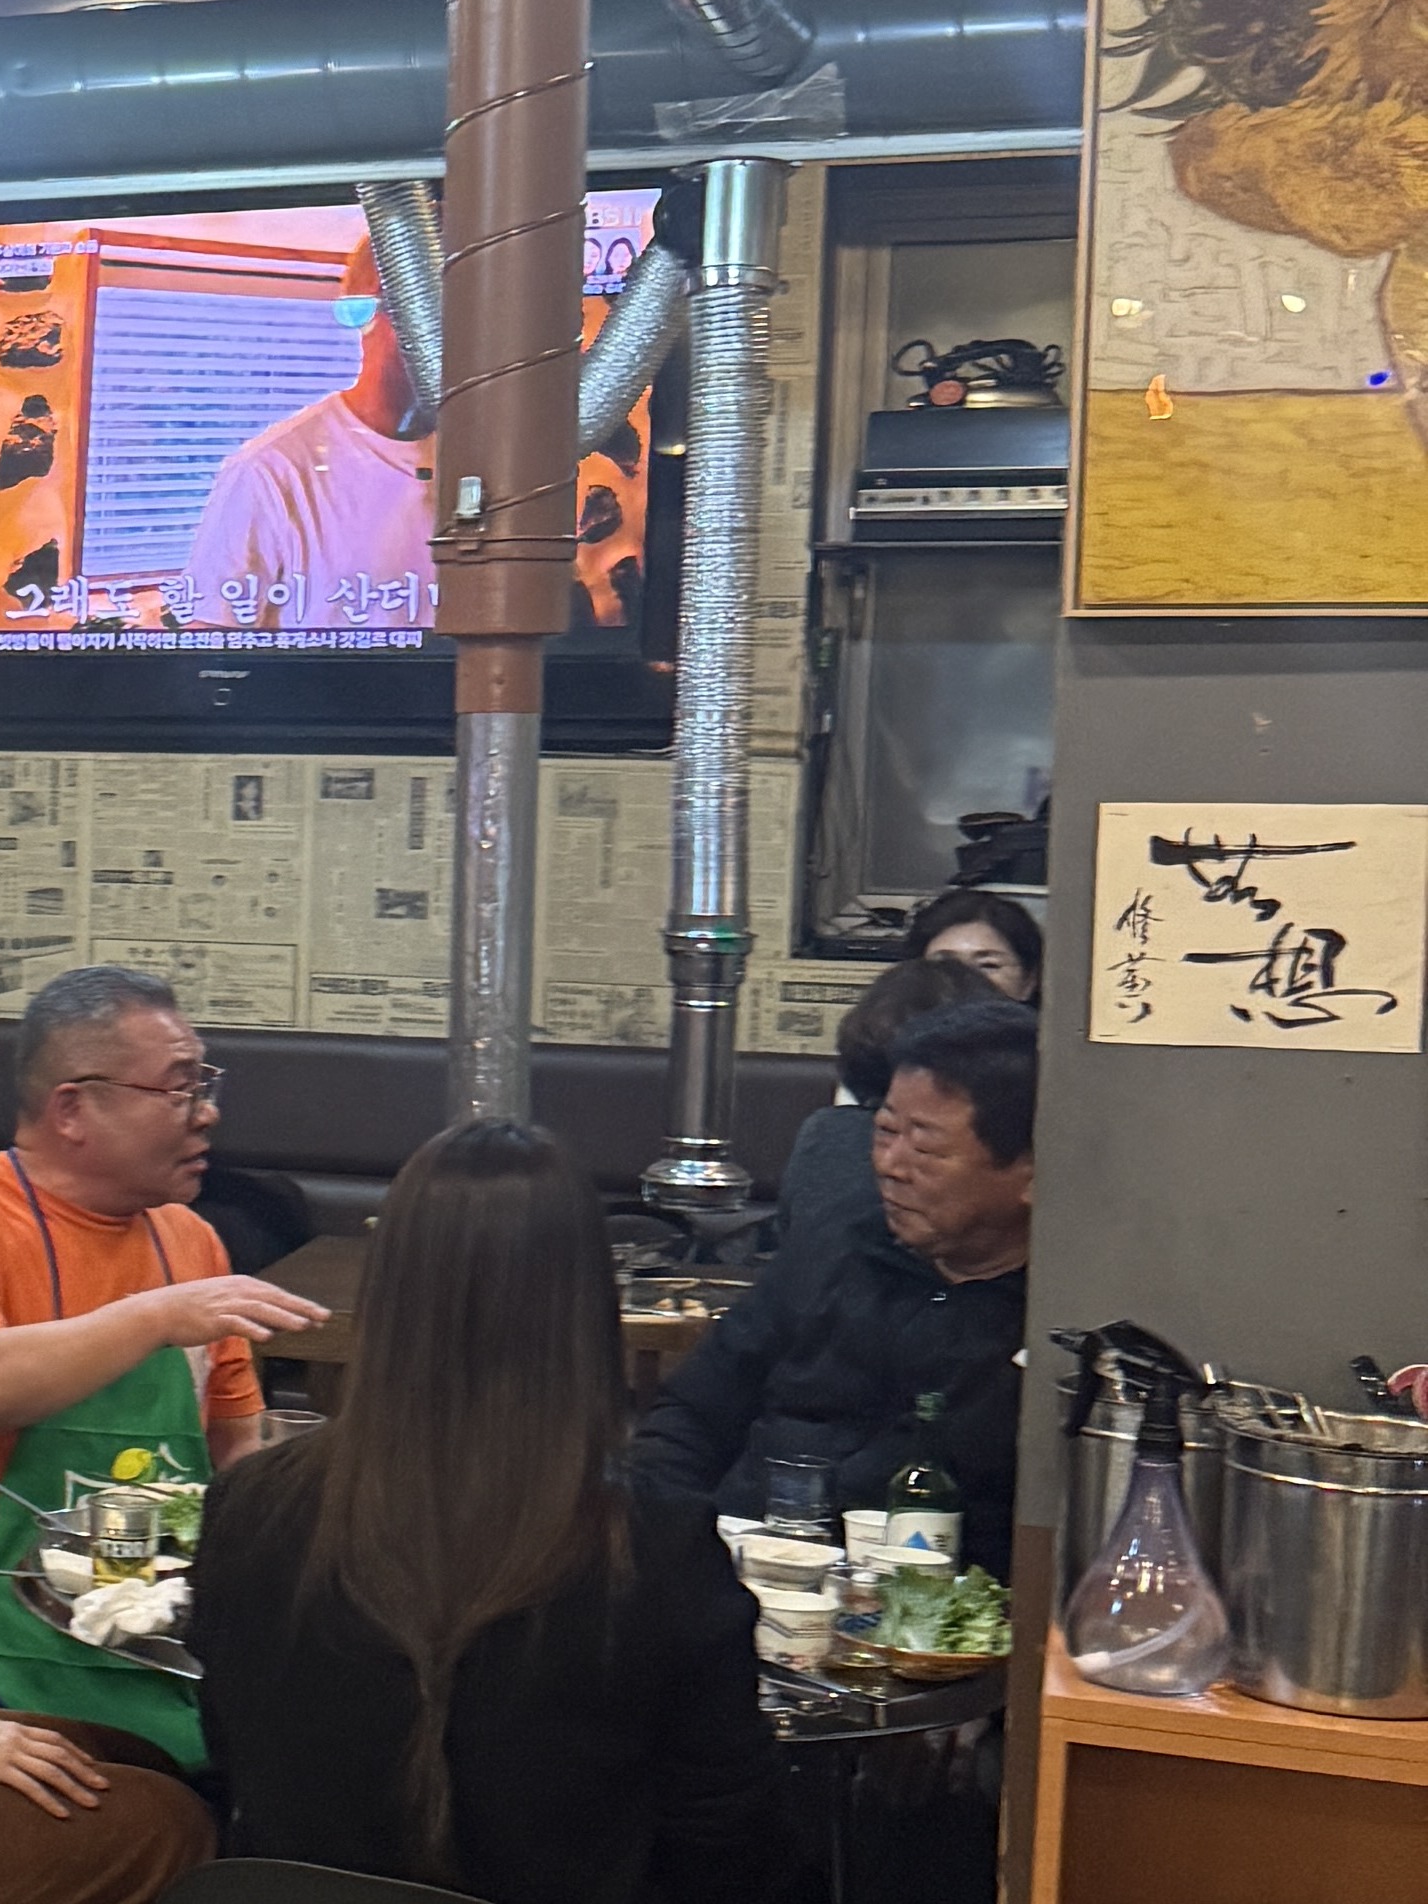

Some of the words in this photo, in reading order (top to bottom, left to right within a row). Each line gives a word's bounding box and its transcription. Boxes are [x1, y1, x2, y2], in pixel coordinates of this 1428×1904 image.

[5, 575, 141, 625] 그래도
[159, 574, 204, 625] 할
[221, 571, 306, 625] 일이
[327, 571, 439, 624] 산더
